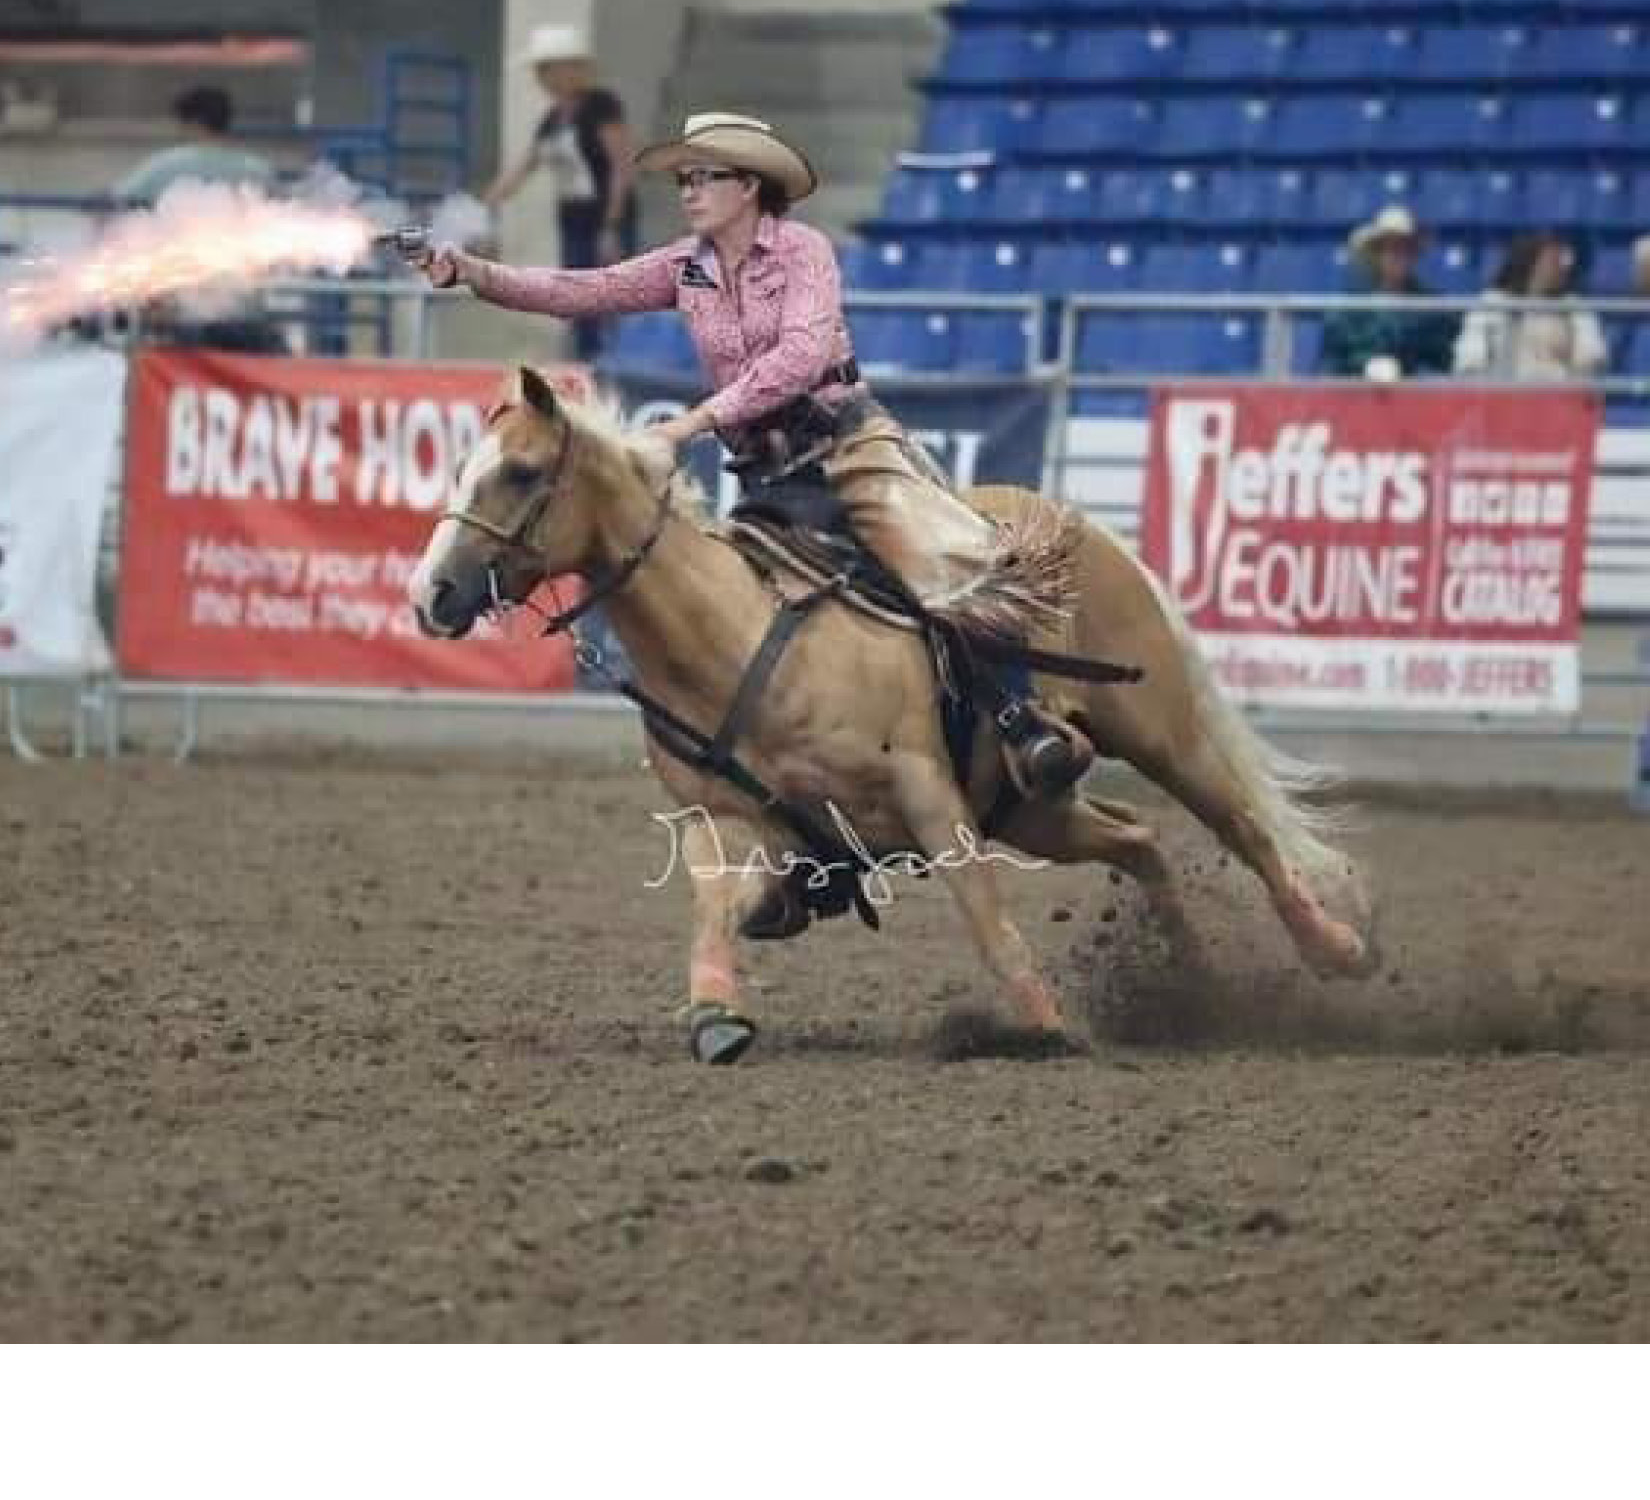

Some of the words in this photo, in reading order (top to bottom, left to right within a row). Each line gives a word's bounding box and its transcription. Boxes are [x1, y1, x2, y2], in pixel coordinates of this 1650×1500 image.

[164, 384, 342, 505] BRAVE
[183, 536, 304, 592] Helping
[306, 548, 378, 590] your
[1216, 526, 1422, 630] EQUINE
[190, 585, 243, 625] the
[247, 591, 313, 631] best
